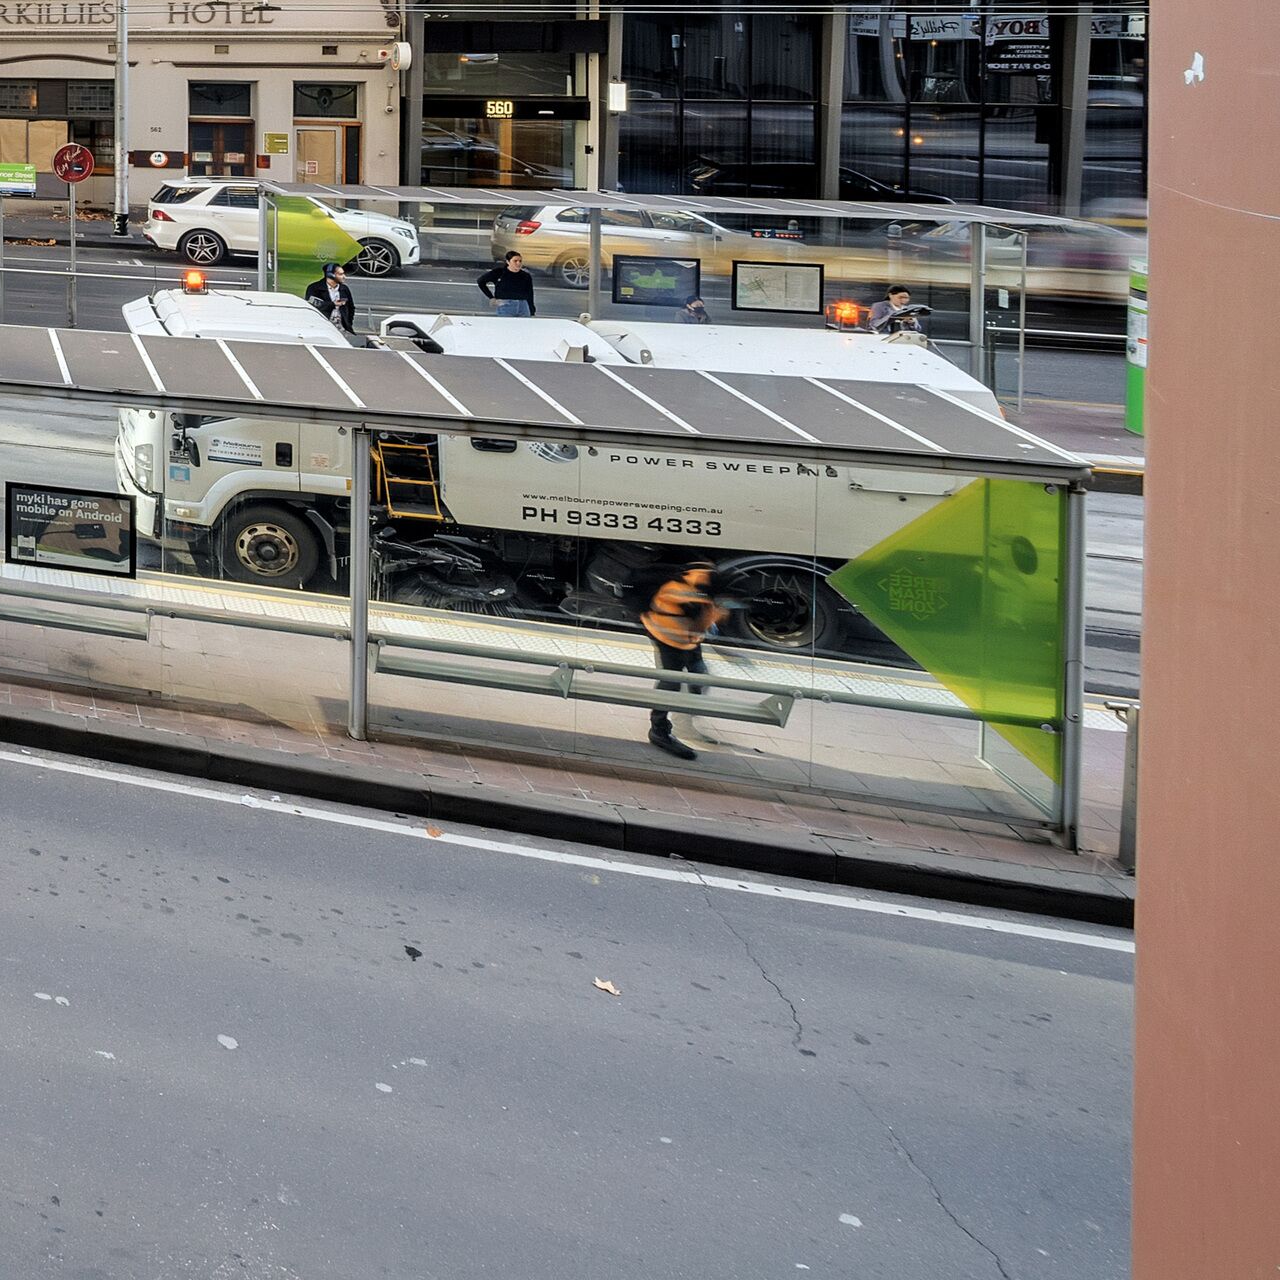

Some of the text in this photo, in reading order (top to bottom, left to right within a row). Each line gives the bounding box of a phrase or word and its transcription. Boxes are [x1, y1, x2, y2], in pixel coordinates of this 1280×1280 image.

[167, 1, 274, 24] HOTEL
[486, 100, 513, 114] 560
[610, 454, 694, 468] POWER
[16, 493, 100, 510] myki has gone
[522, 493, 724, 515] www.melbournepowersweeping.com.au
[16, 504, 56, 516] mobile
[58, 508, 73, 518] on
[75, 509, 122, 523] Android
[522, 506, 722, 536] PH 9333 4333
